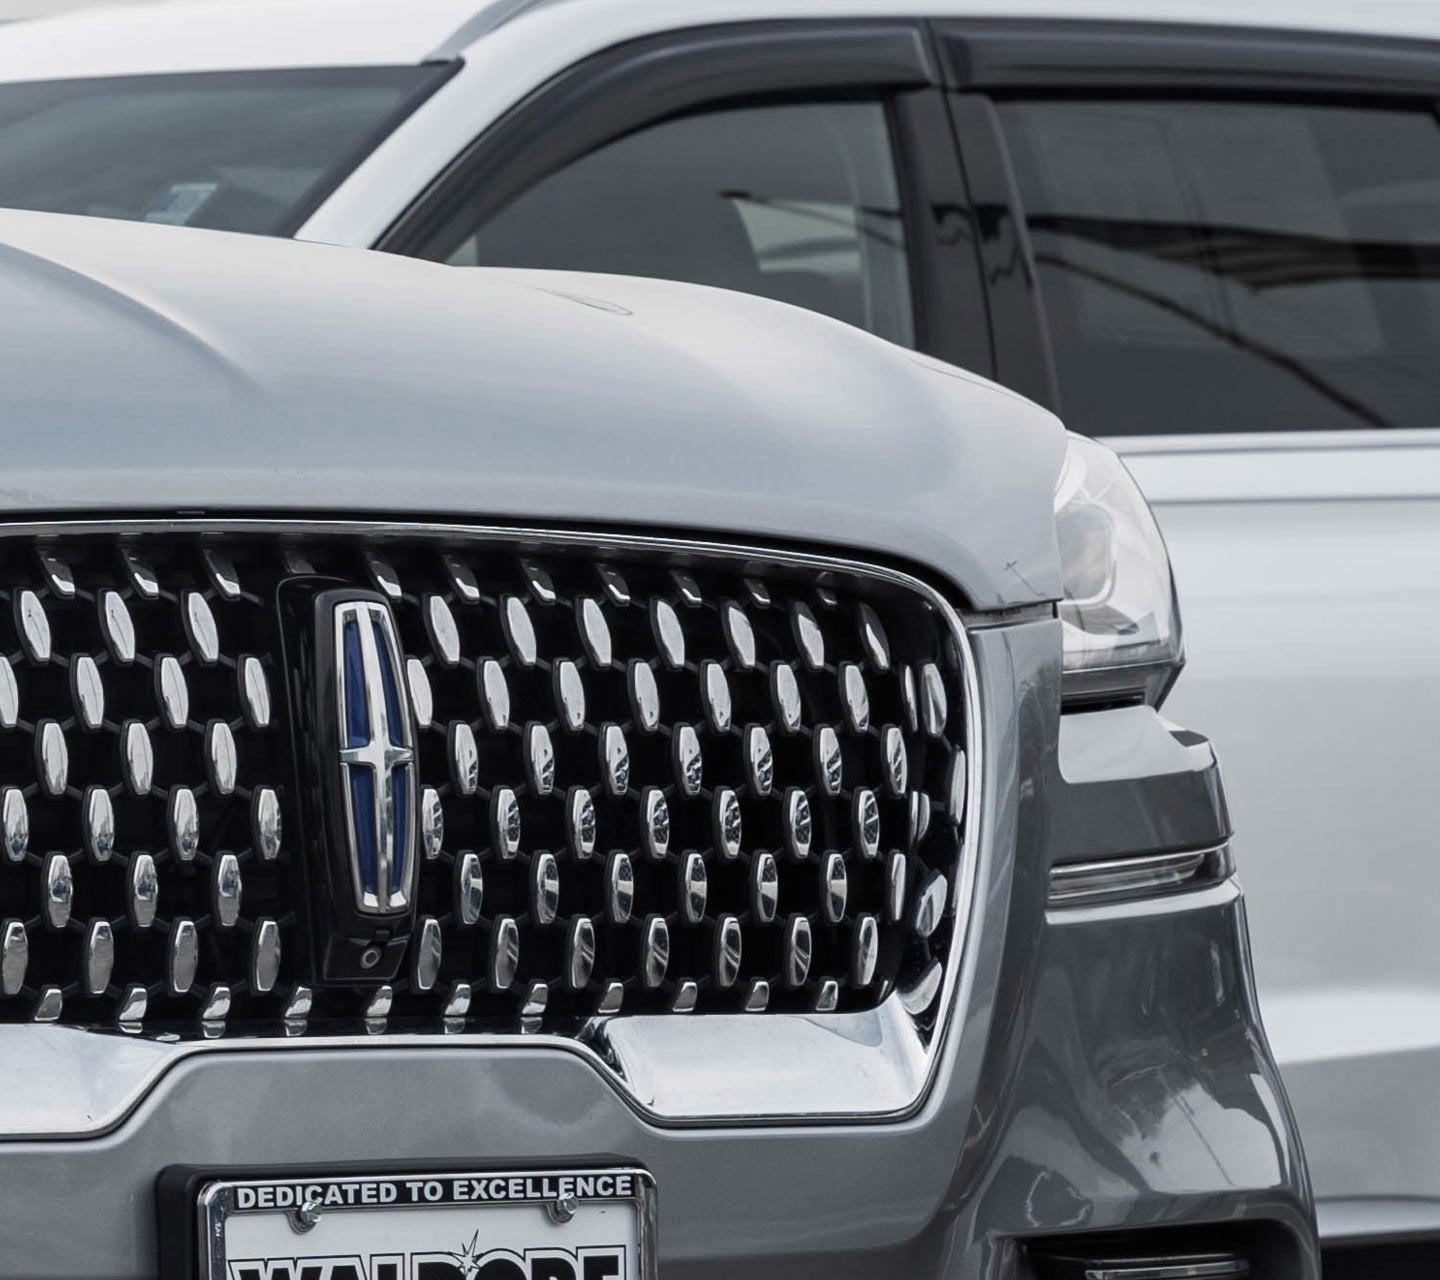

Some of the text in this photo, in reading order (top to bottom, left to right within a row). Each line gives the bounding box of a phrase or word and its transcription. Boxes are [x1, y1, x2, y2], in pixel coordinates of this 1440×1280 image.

[237, 1175, 632, 1209] DEDICATED TO EXCELLENCE
